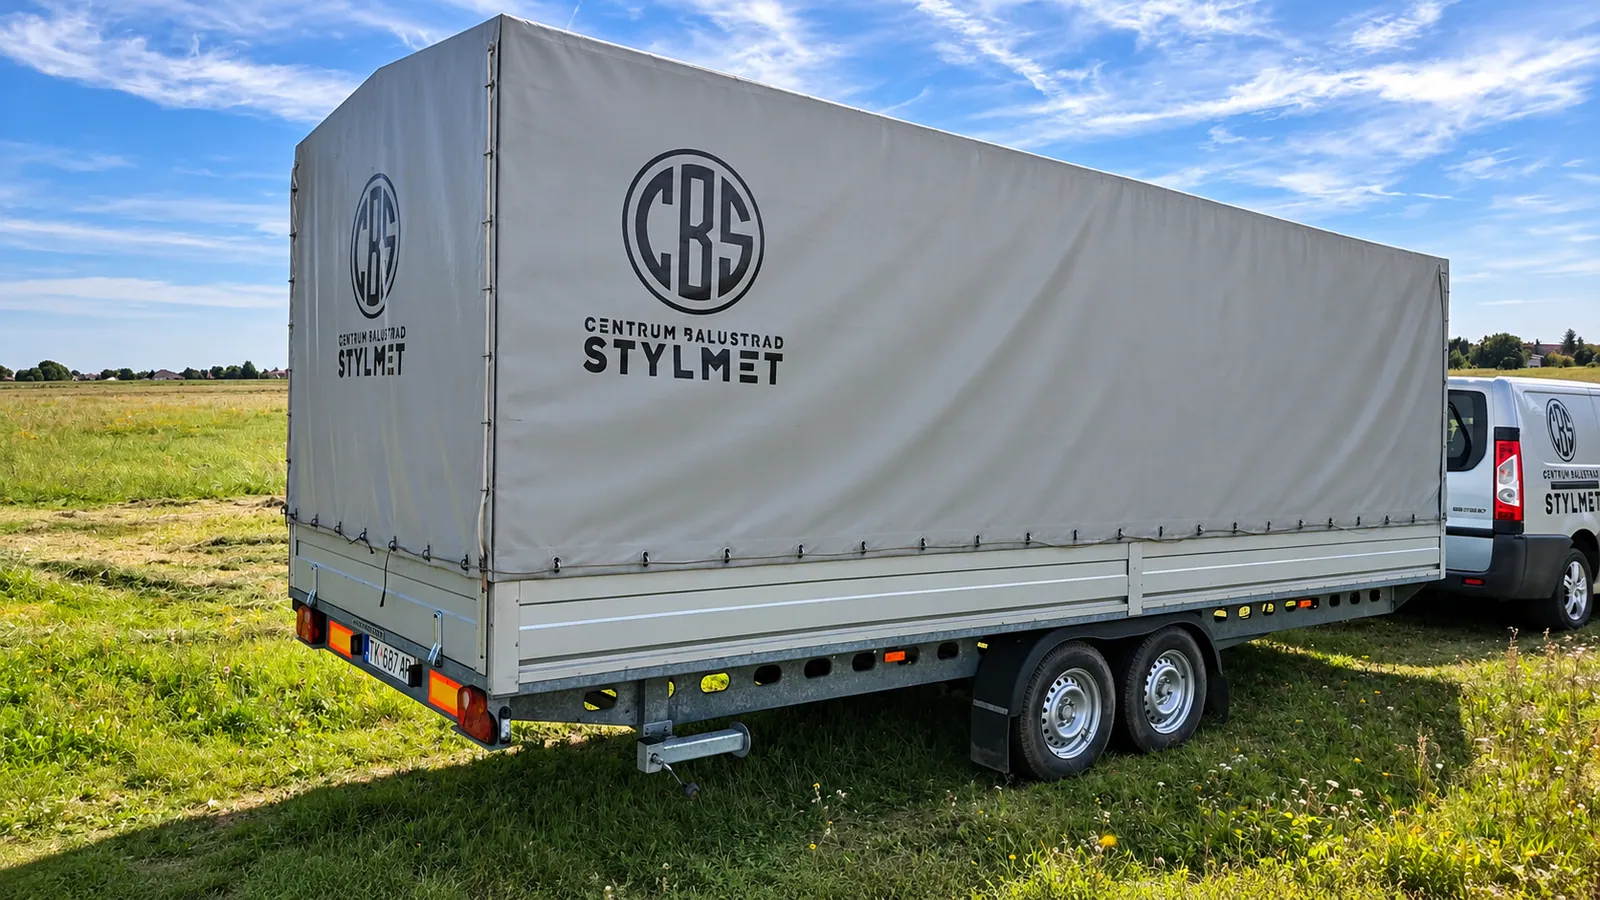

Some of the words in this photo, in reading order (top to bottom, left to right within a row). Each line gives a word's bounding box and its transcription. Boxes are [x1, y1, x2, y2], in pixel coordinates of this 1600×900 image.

[354, 186, 396, 307] CBS
[635, 164, 754, 301] CBS
[339, 331, 367, 347] CENTRUM
[584, 316, 676, 341] CENTRUM
[684, 326, 785, 350] BALUSTRAD
[338, 342, 406, 378] STYLMET
[583, 335, 784, 386] STYLMET
[1550, 403, 1574, 458] CBS
